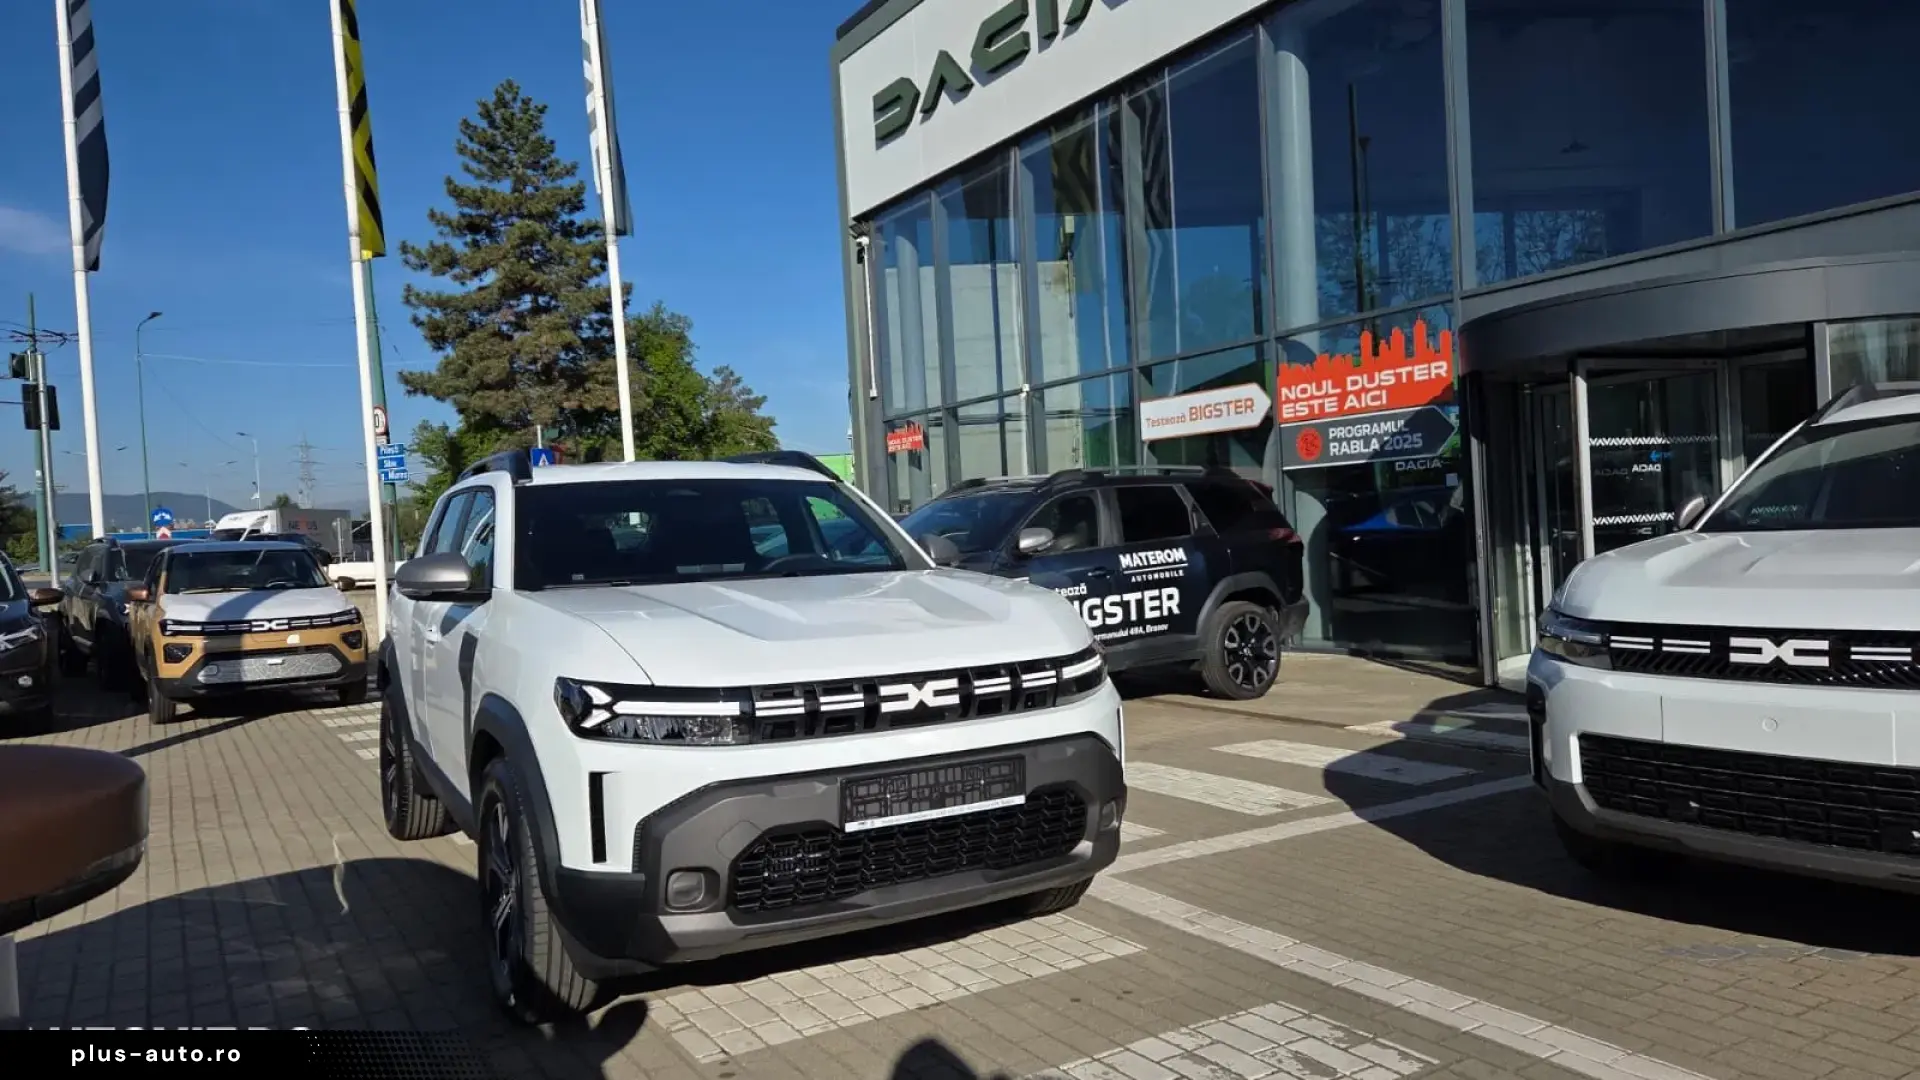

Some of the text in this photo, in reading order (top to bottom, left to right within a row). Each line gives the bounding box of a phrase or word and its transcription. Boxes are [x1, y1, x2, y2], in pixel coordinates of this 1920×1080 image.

[873, 0, 1098, 141] DACI
[1281, 361, 1448, 401] NOUL DUSTER
[1188, 397, 1255, 422] BIGSTER
[1282, 389, 1388, 419] ESTE AICI
[1328, 420, 1409, 440] PROGRAMUL
[1329, 433, 1423, 457] RABLA 2025
[1395, 459, 1443, 472] DACIA
[1119, 547, 1187, 568] MATEROM
[1131, 569, 1184, 583] AUTOMOBILE
